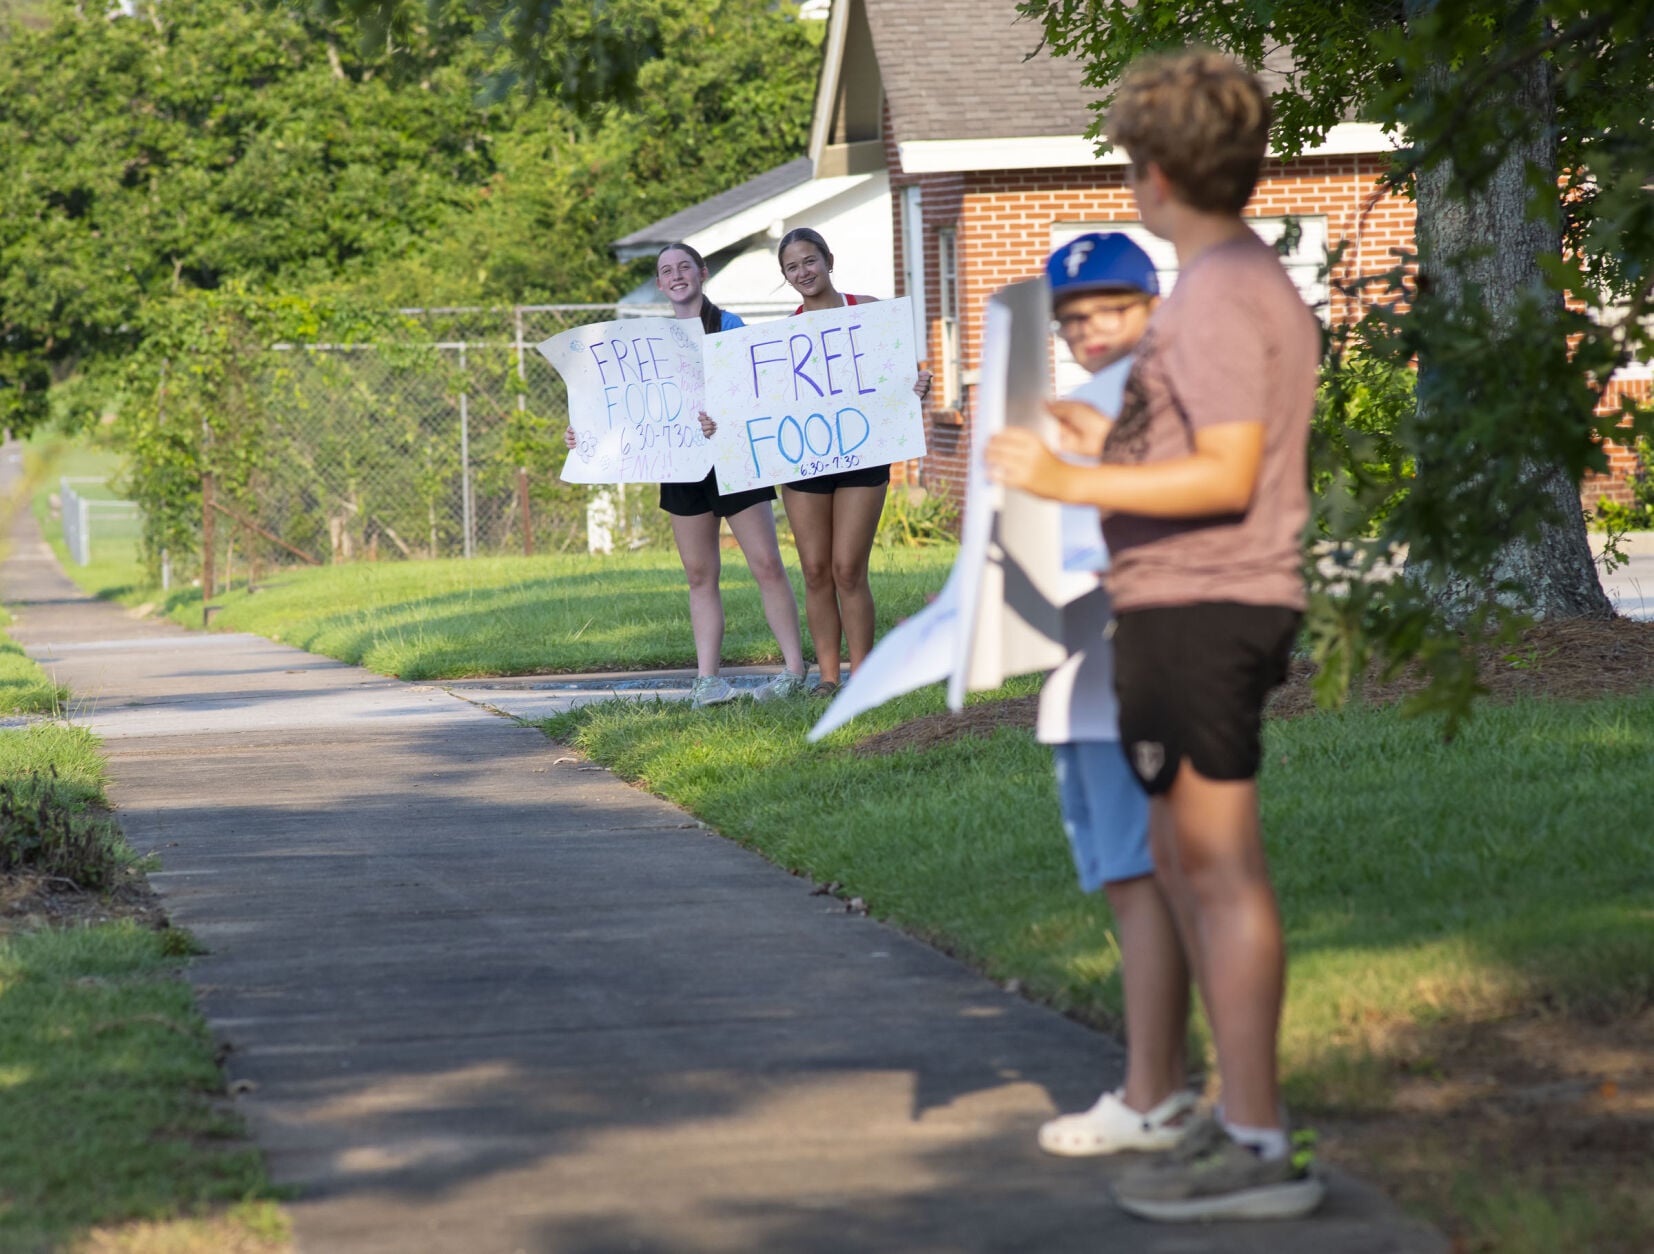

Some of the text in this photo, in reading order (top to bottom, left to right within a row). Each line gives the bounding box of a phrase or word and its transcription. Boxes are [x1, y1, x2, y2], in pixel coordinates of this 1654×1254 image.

[589, 337, 675, 385] FREE
[750, 324, 876, 400] FREE
[603, 381, 683, 430] FOOD
[746, 407, 870, 479] FOOD
